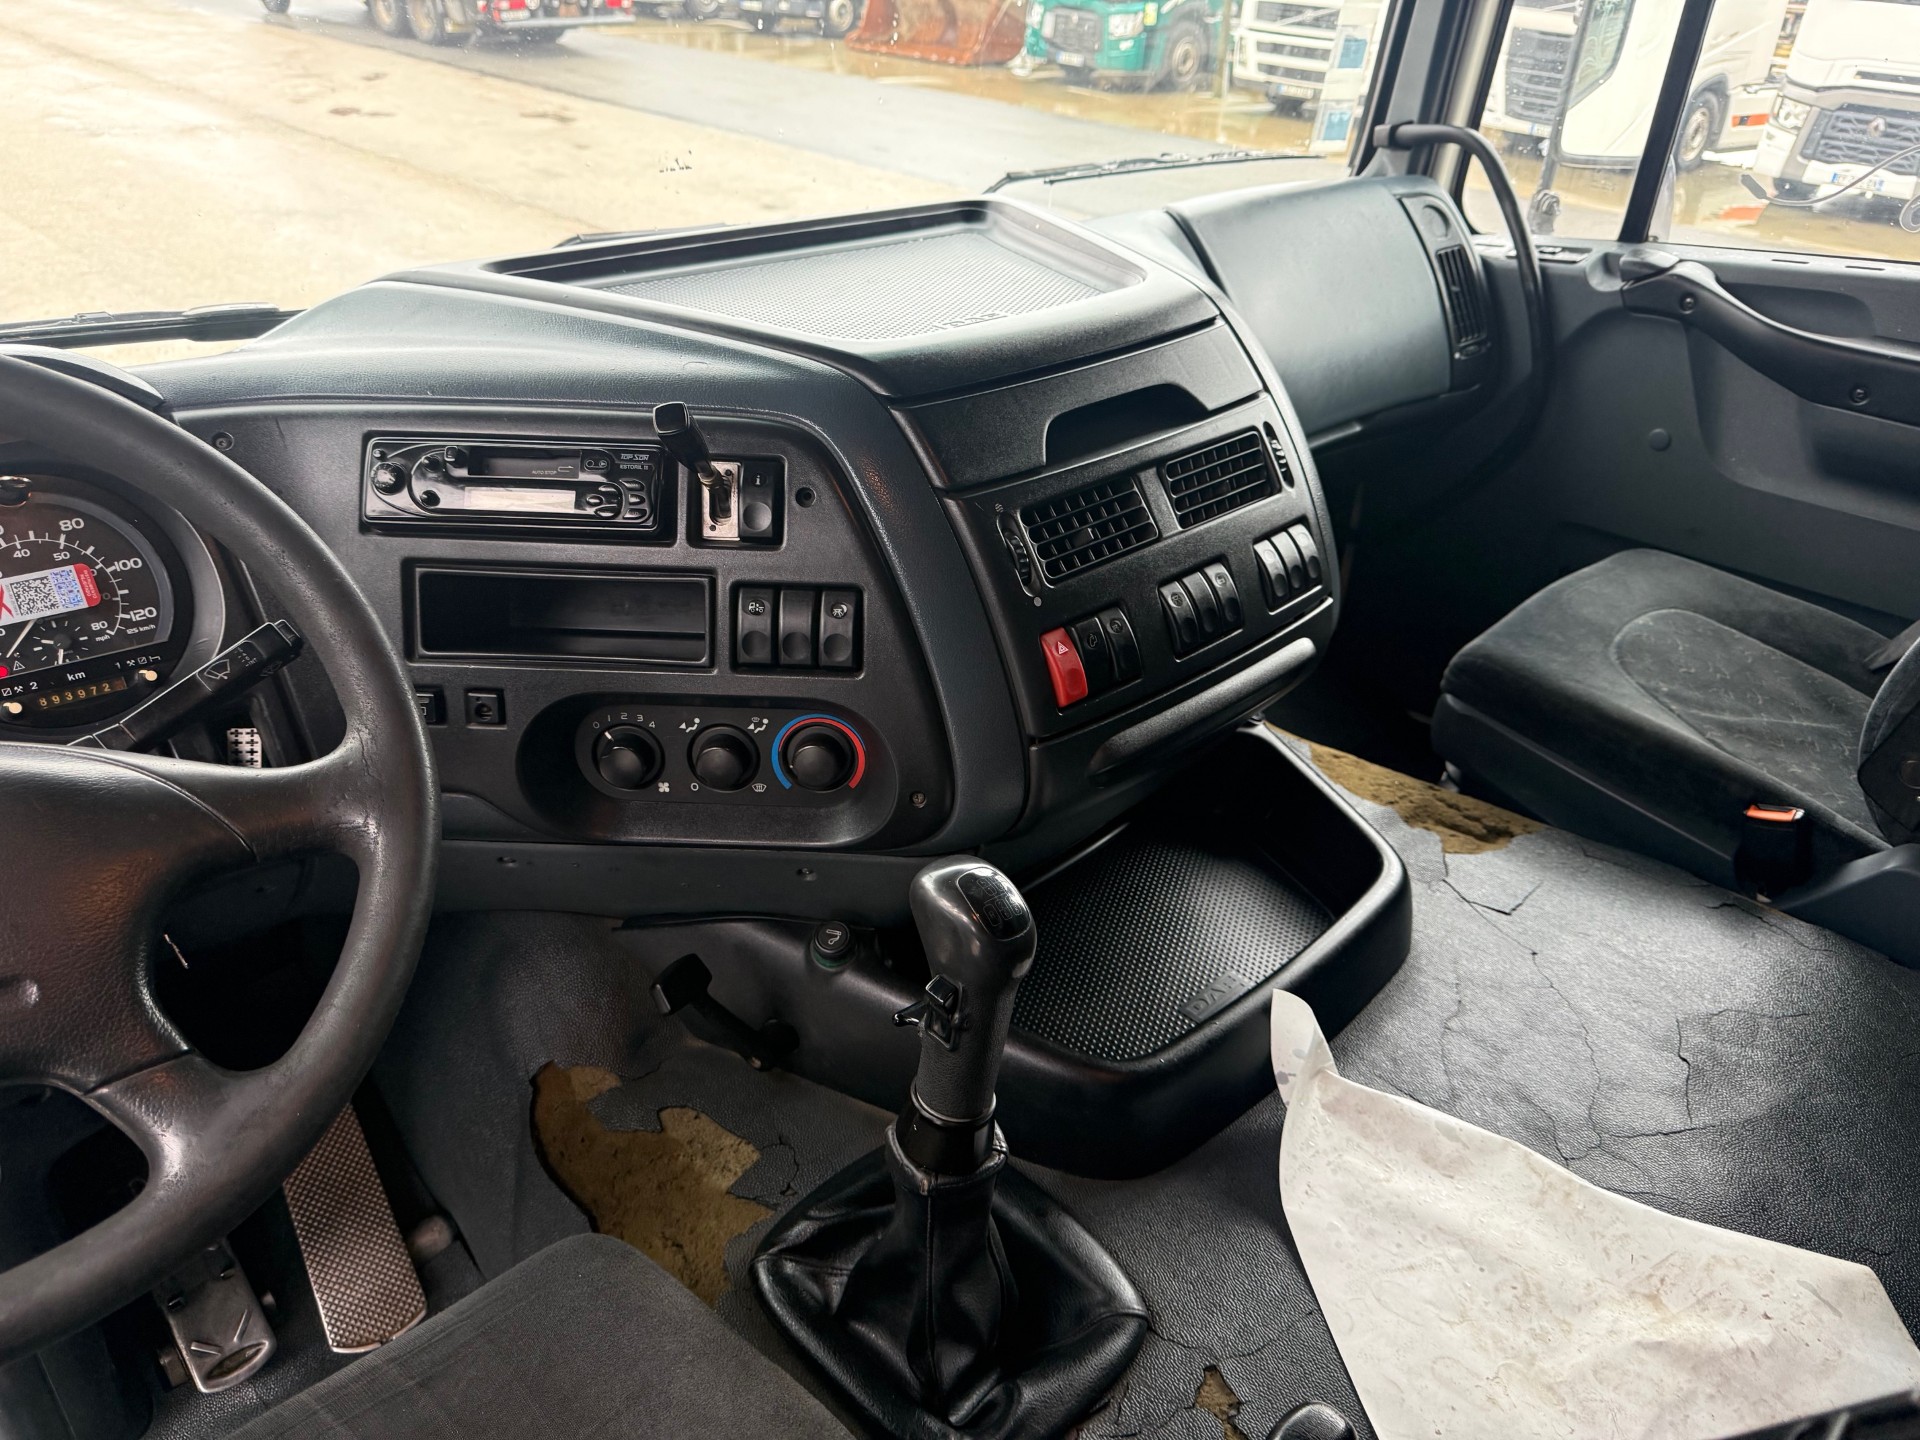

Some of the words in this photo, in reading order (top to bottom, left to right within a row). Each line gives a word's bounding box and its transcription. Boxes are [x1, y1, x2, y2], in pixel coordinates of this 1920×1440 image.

[59, 518, 85, 531] 80
[13, 549, 31, 558] 40
[53, 551, 71, 561] 50
[114, 558, 143, 572] 100
[129, 606, 158, 622] 120
[91, 621, 108, 631] 80
[139, 624, 156, 632] km/h
[67, 671, 86, 682] km
[30, 681, 38, 690] 2
[637, 714, 644, 722] 3
[648, 721, 656, 729] 4
